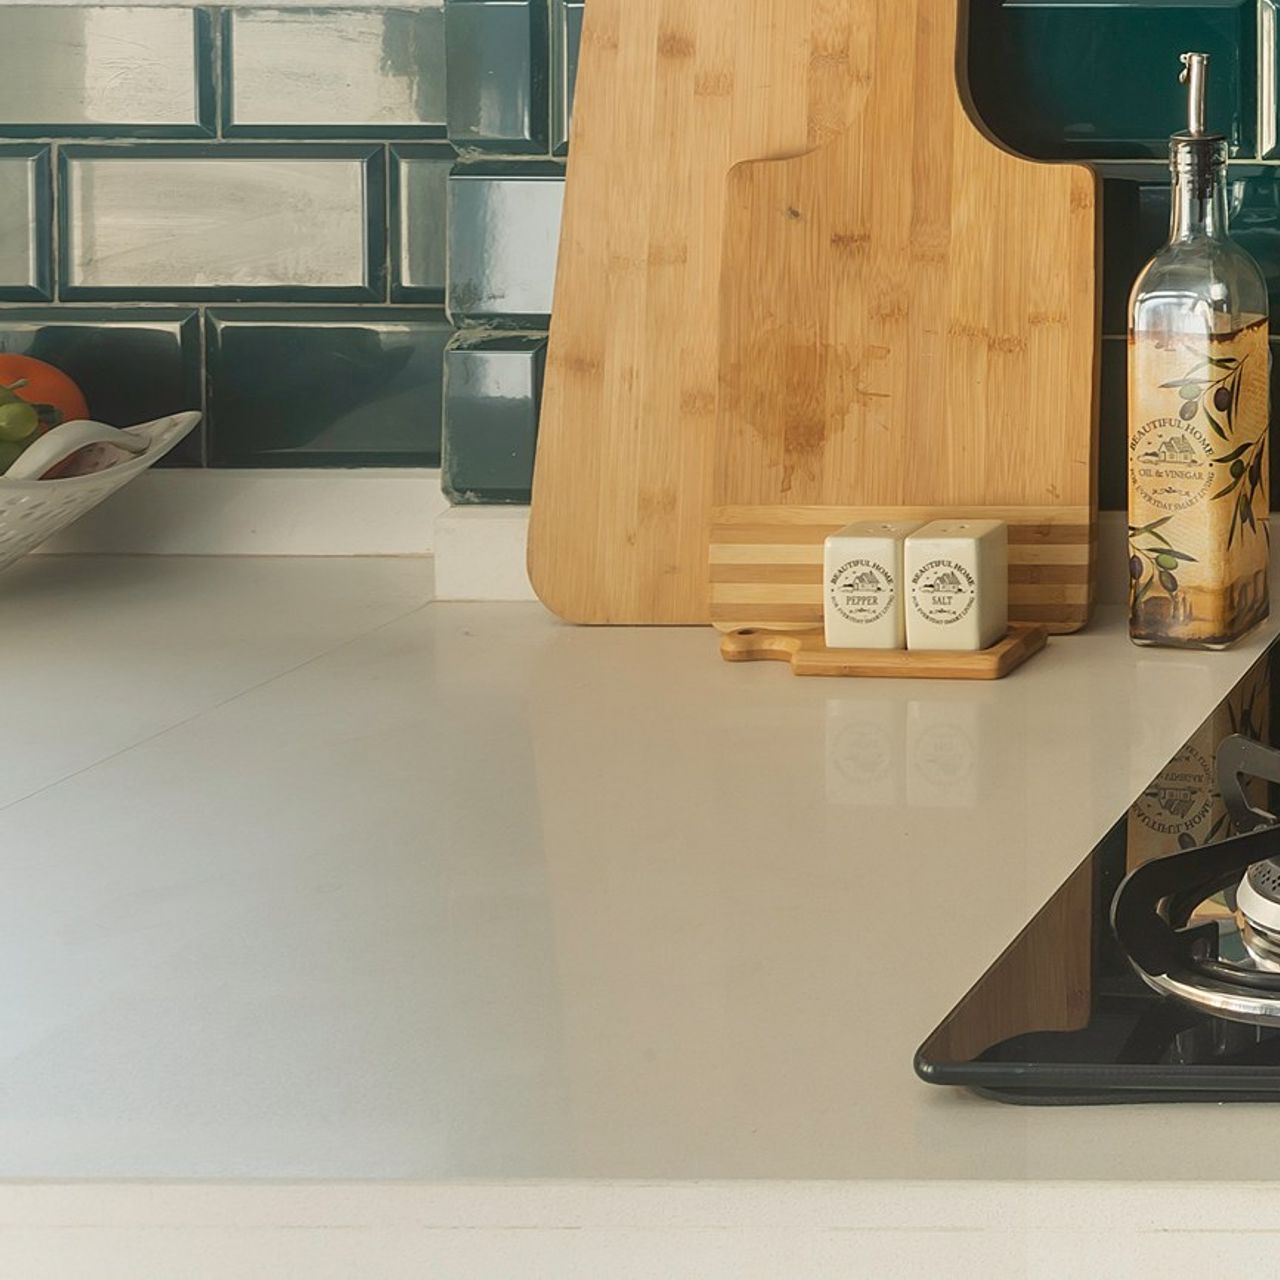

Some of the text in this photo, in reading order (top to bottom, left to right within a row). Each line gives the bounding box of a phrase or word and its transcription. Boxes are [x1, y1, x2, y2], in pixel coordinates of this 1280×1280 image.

[1130, 418, 1214, 457] BEAUTIFUL HOME
[1139, 469, 1204, 480] OIL & VINEGAR
[1136, 485, 1173, 511] EVERYDAY
[1173, 495, 1199, 511] SMART
[831, 559, 894, 586] BEAUTIFUL HOME
[912, 559, 976, 587] BEAUTIFUL HOME
[845, 595, 879, 606] PEPPER
[931, 595, 953, 606] SALT
